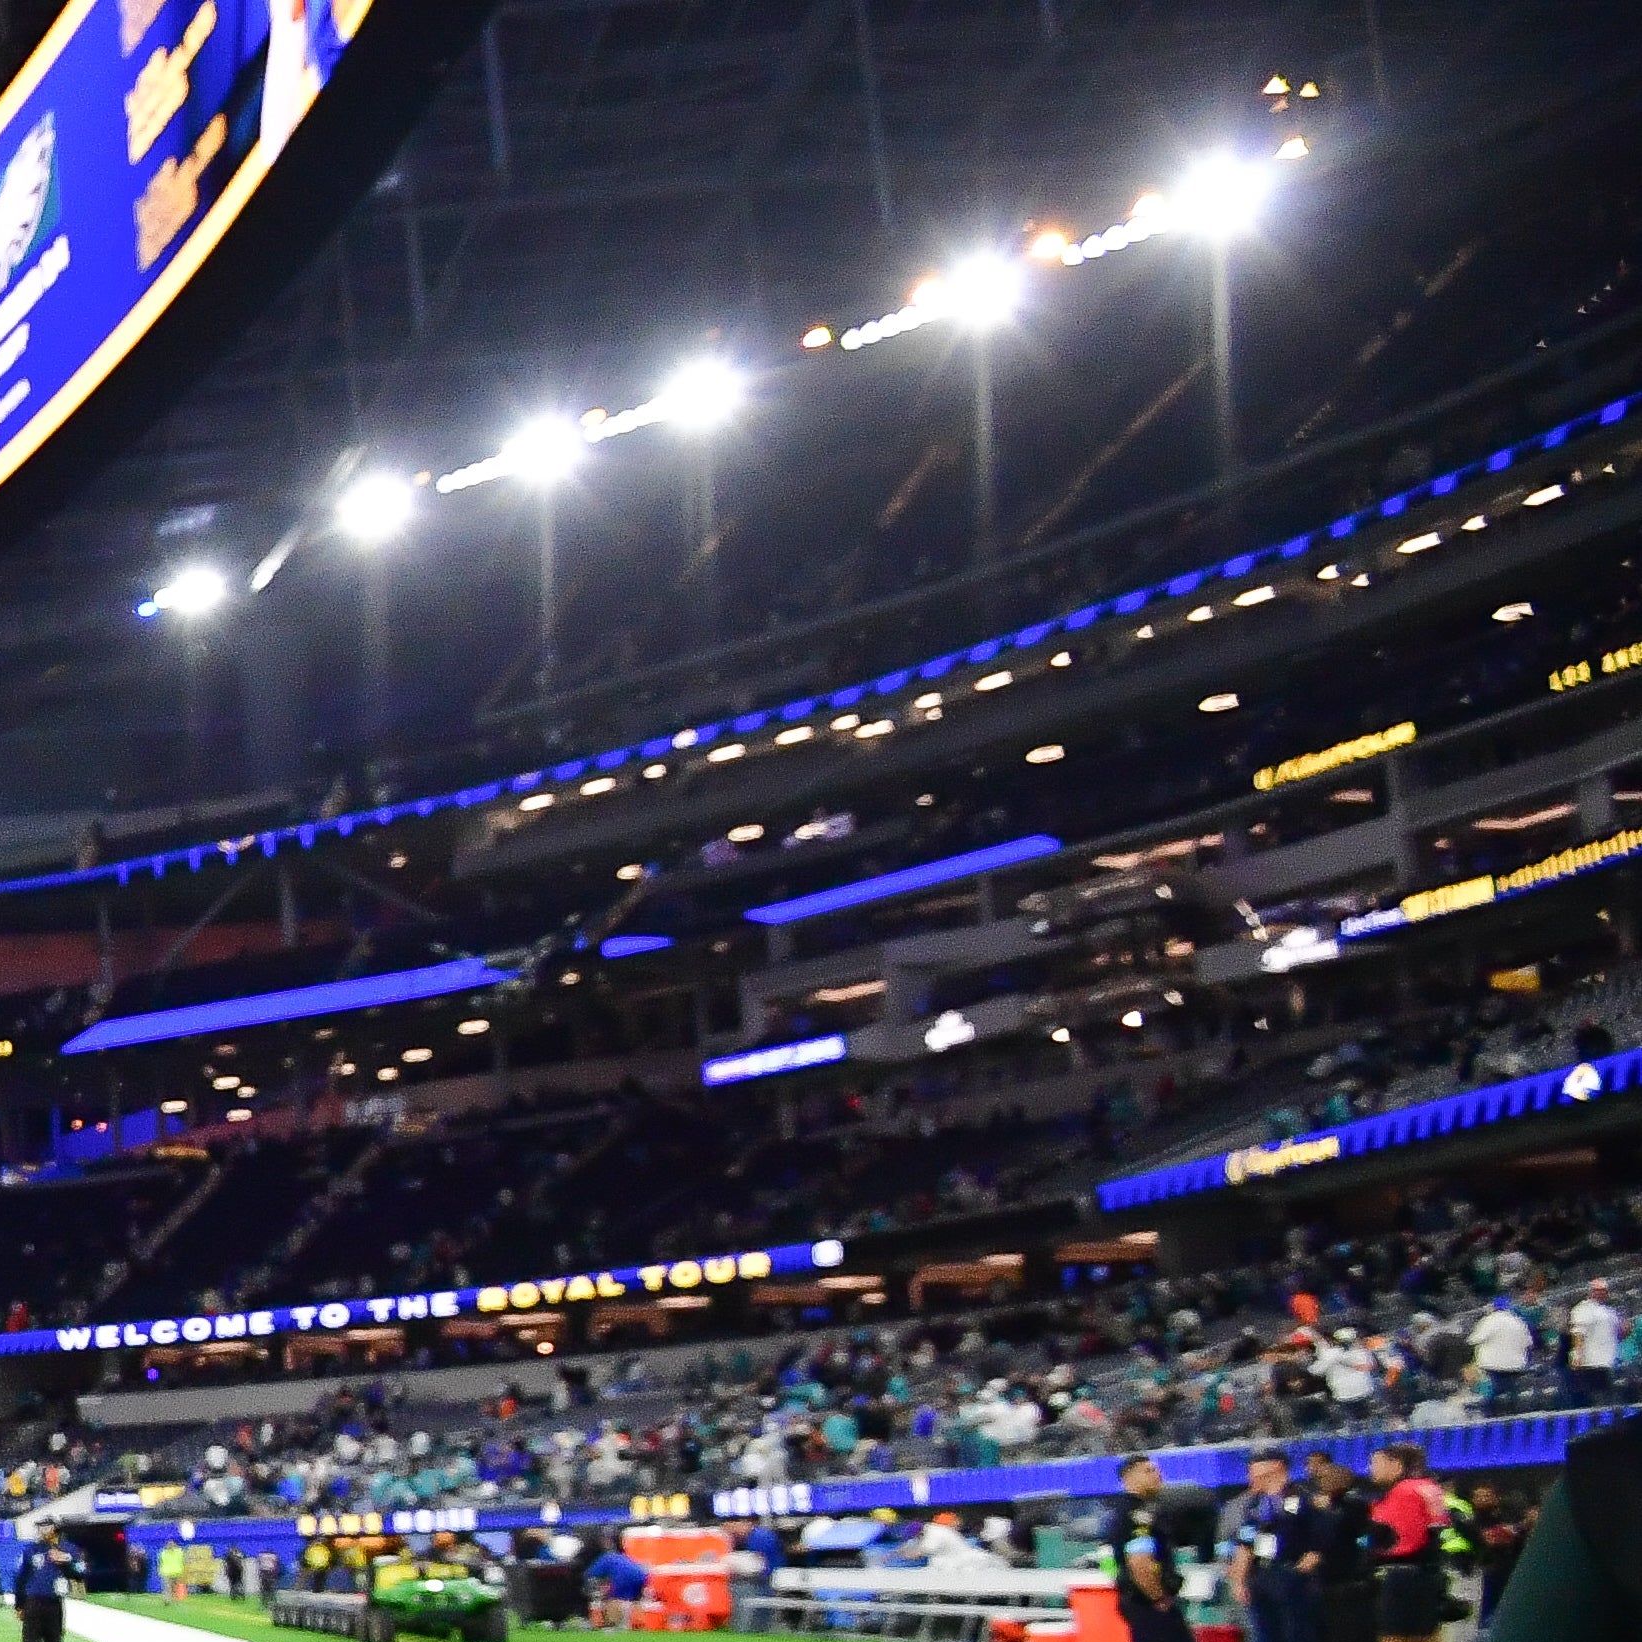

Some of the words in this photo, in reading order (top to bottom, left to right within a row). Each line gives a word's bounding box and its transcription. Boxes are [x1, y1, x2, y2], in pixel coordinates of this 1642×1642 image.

[56, 1311, 276, 1351] WELCOME
[291, 1303, 351, 1330] TO
[366, 1291, 459, 1323] THE
[476, 1273, 626, 1313] ROYAL
